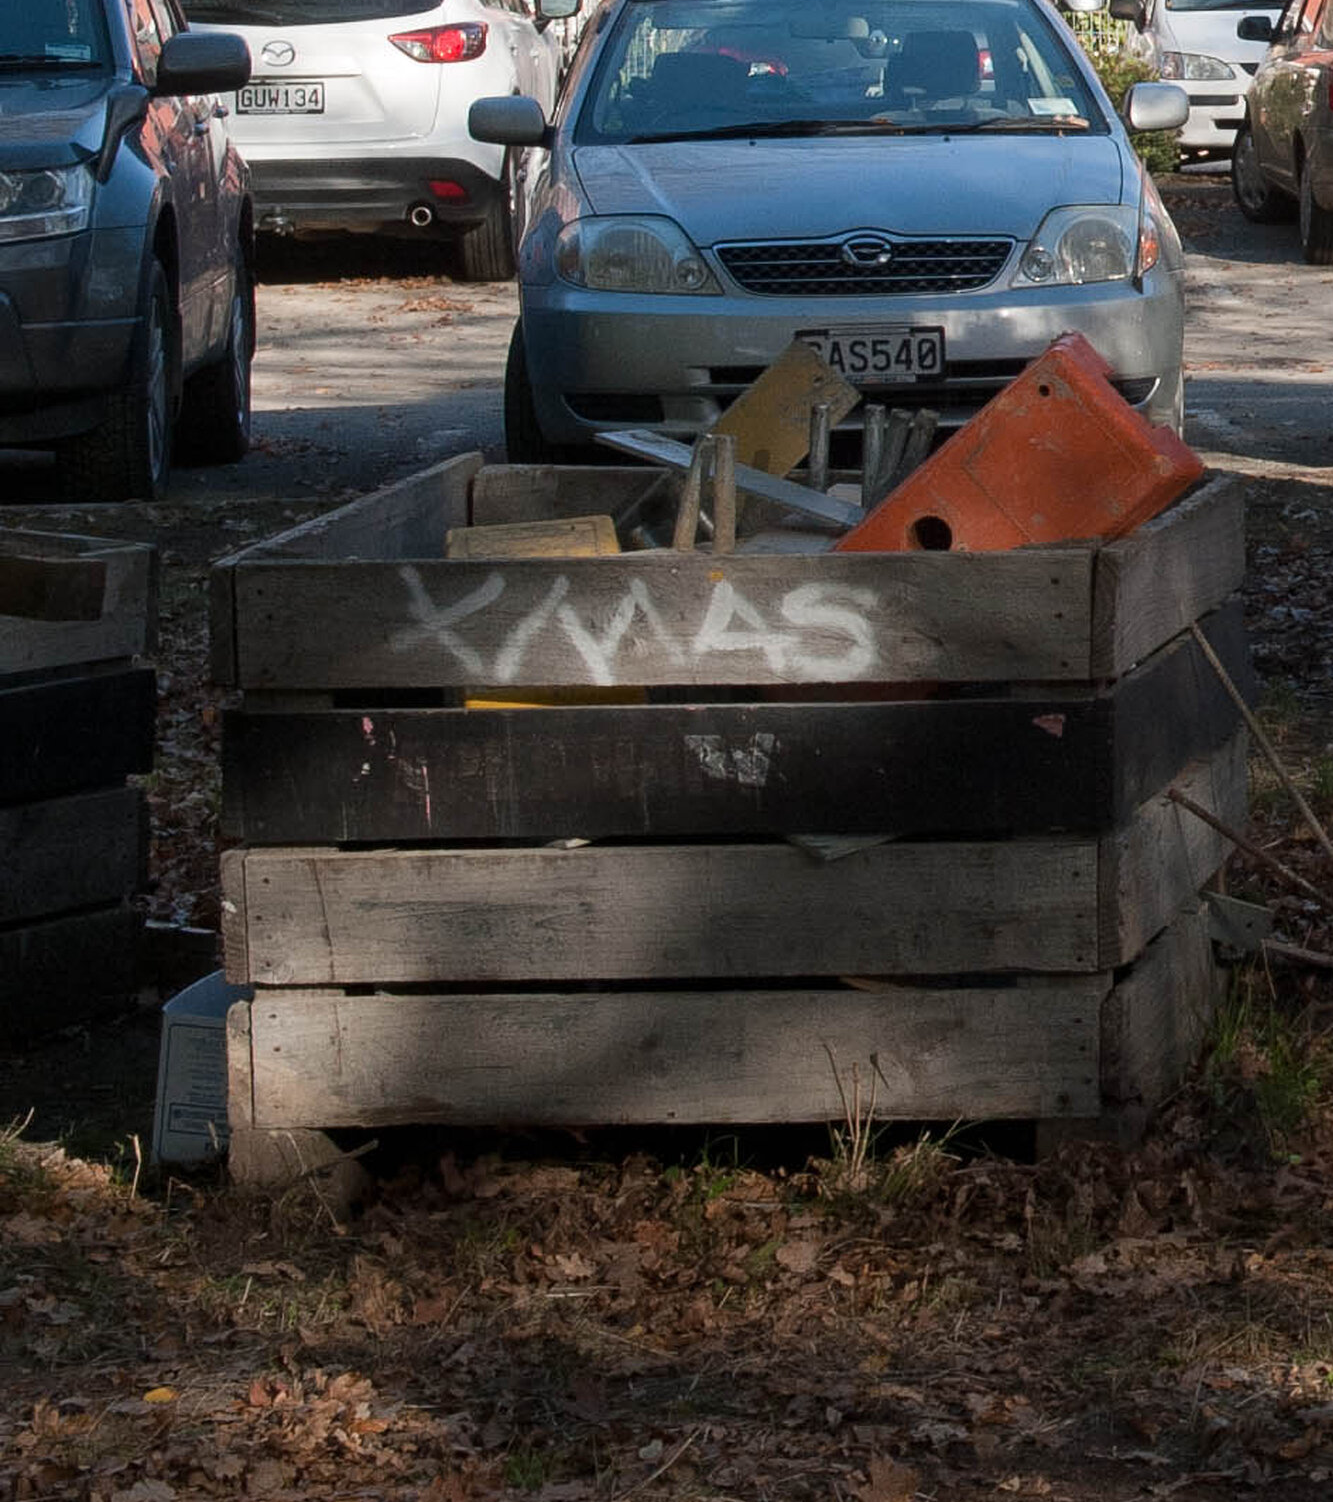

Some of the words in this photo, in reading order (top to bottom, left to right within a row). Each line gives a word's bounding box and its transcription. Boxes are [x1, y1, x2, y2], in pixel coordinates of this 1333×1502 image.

[241, 88, 319, 108] GUW134
[804, 337, 937, 373] AS540
[390, 565, 881, 686] XMAS
